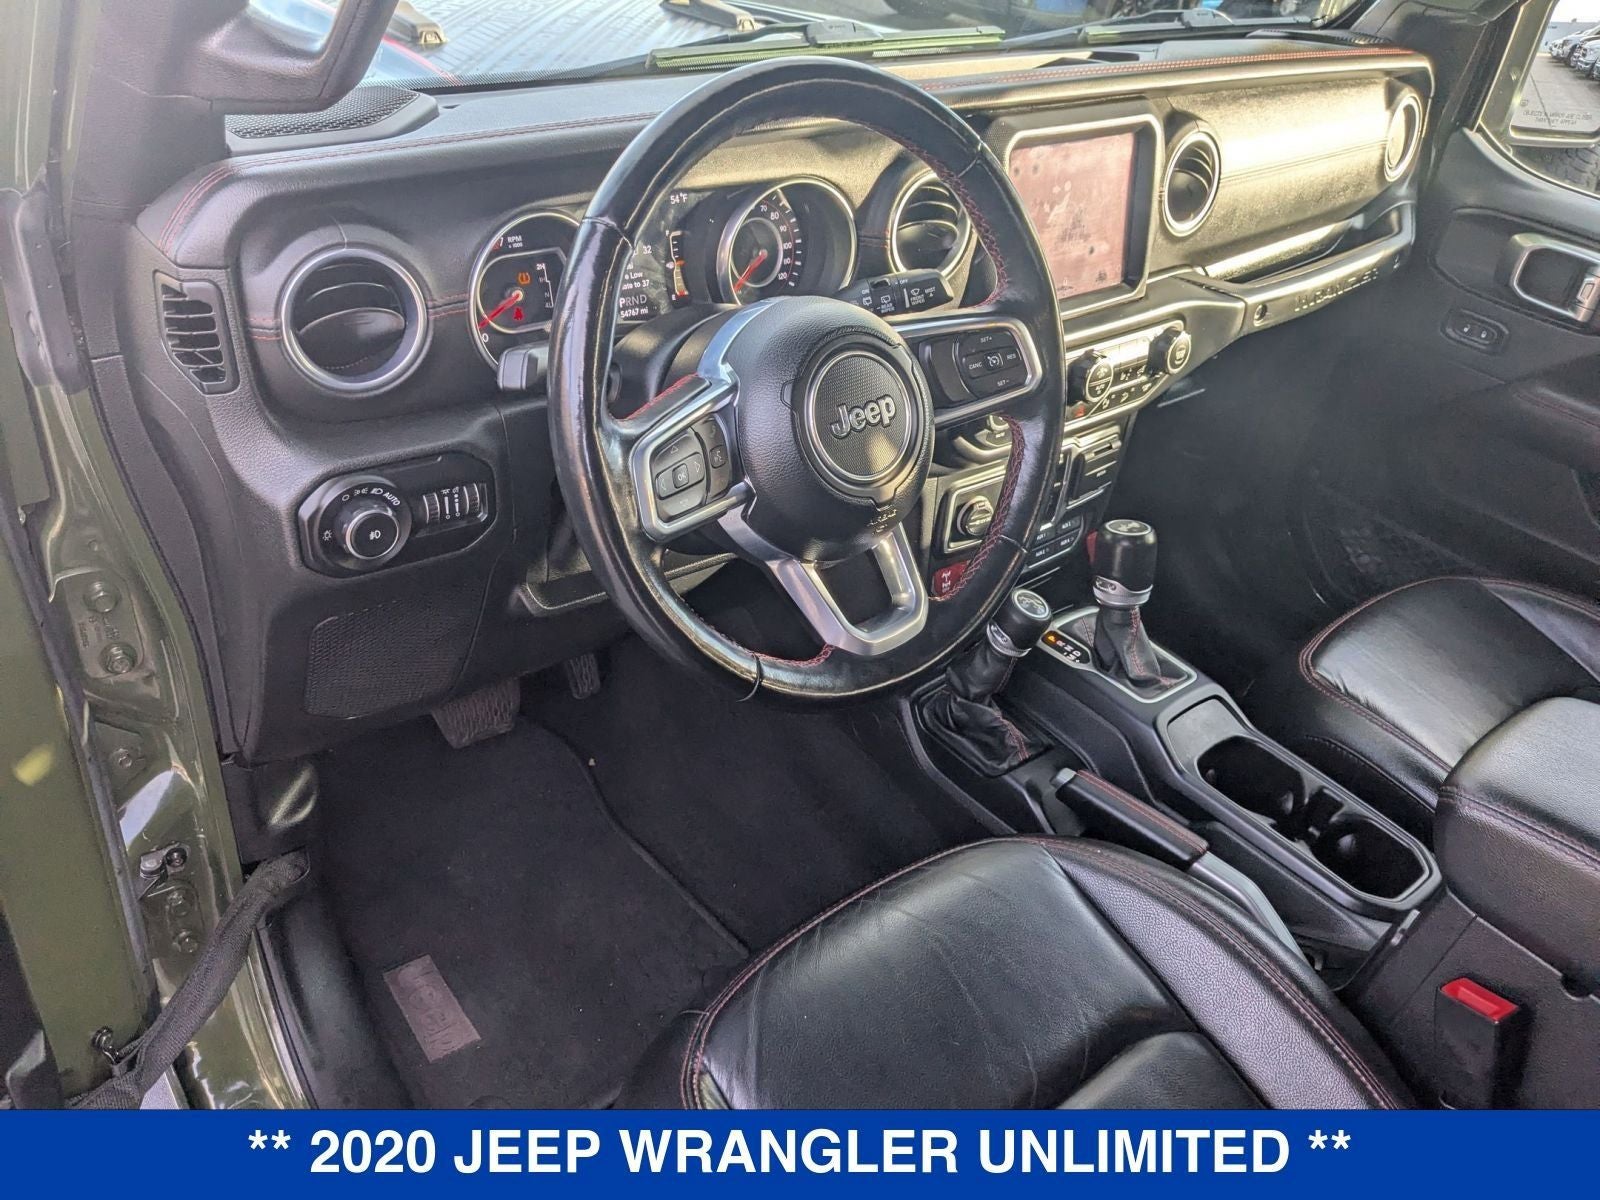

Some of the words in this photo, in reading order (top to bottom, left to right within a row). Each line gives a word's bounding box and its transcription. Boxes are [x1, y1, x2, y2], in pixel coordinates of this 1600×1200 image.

[770, 211, 780, 220] 80
[507, 235, 522, 243] RPM
[830, 394, 897, 440] Jeep
[383, 491, 401, 506] AUTO
